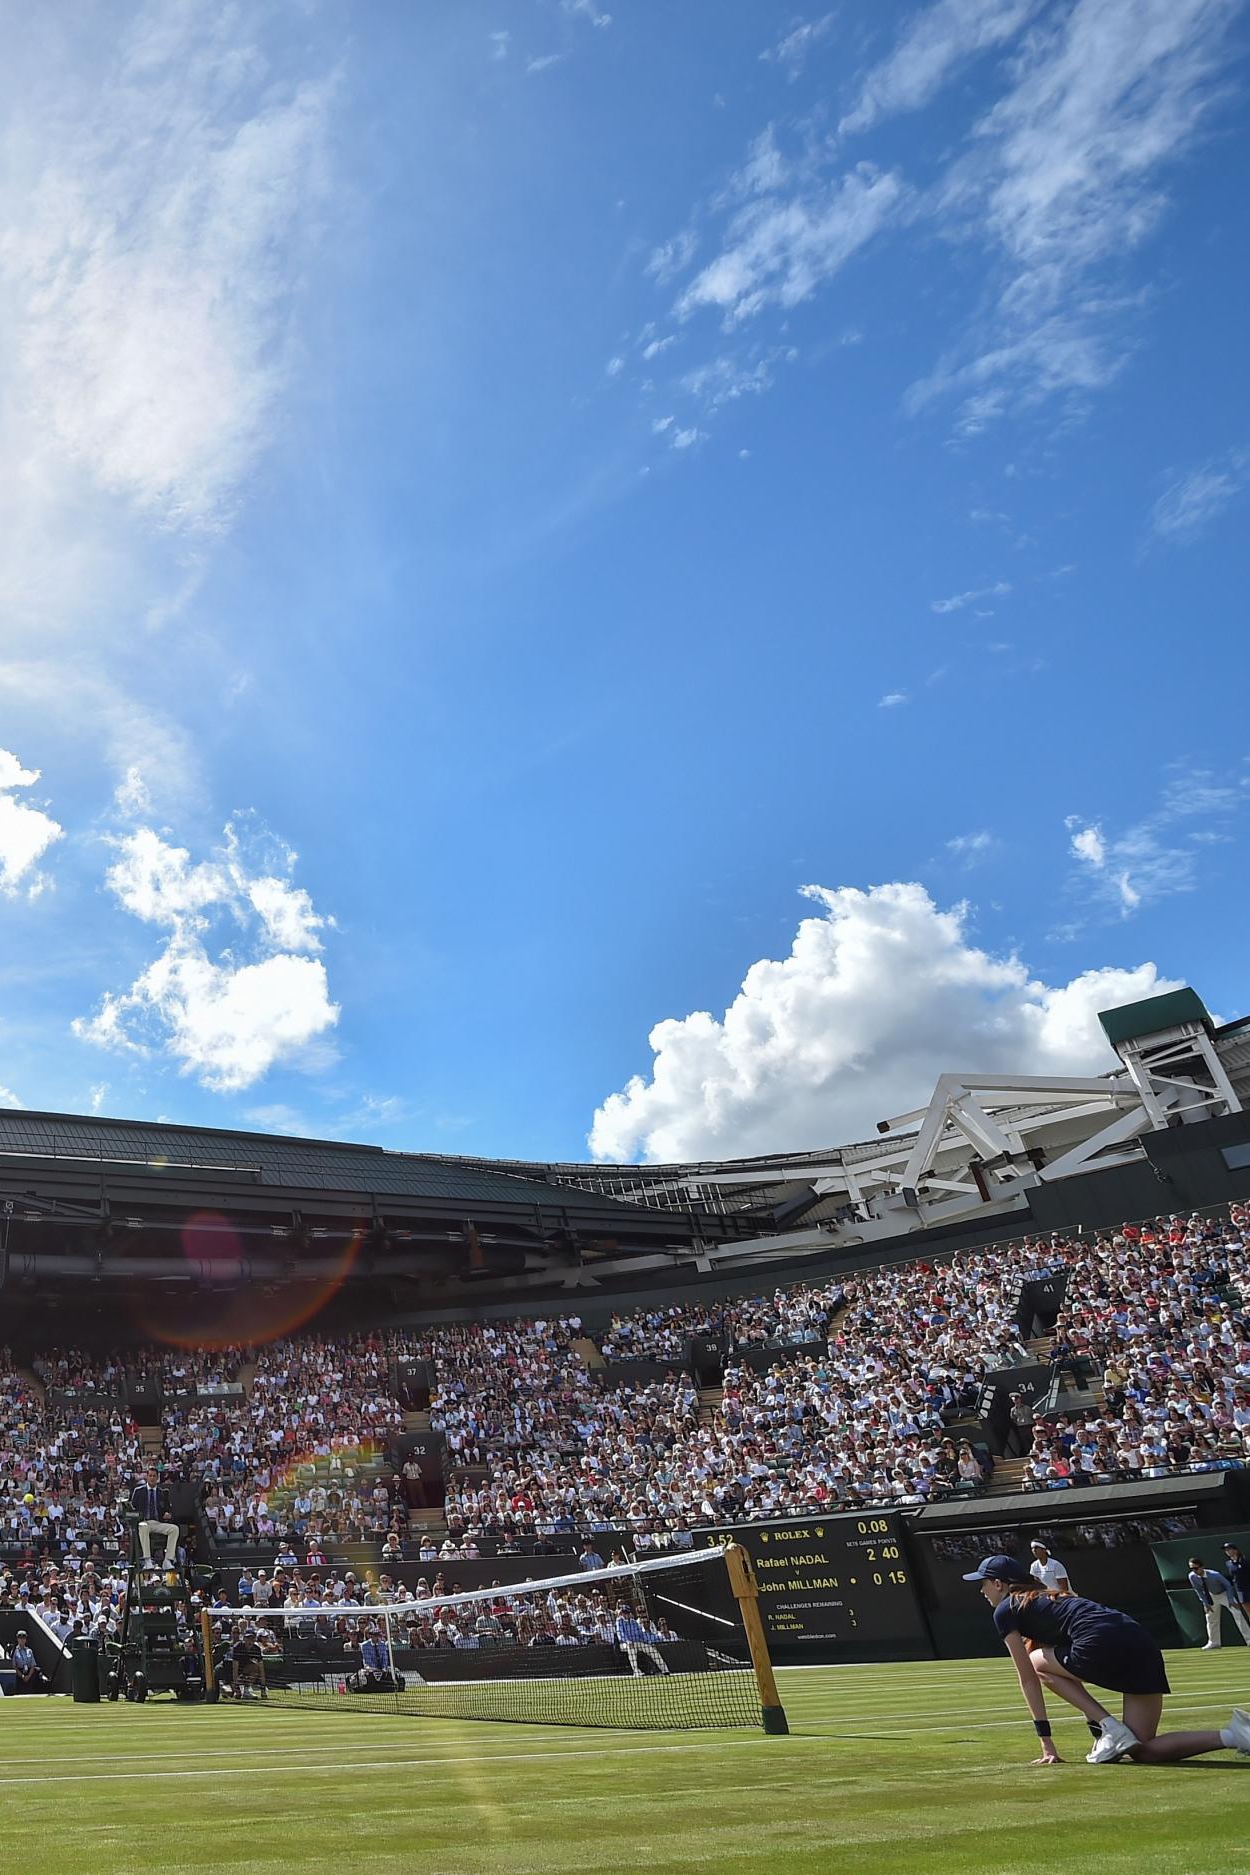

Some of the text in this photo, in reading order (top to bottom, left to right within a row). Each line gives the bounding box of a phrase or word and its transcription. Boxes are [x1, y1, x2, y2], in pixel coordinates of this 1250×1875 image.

[1043, 1284, 1055, 1293] 41
[706, 1343, 717, 1351] 39
[406, 1368, 417, 1376] 37
[135, 1385, 145, 1393] 35
[1018, 1381, 1035, 1393] 34
[413, 1446, 426, 1455] 32
[857, 1519, 888, 1534] 0.08
[774, 1529, 811, 1541] ROLEX
[706, 1534, 734, 1548] 3.52
[877, 1537, 897, 1545] POINTS
[756, 1546, 899, 1568] Rafael NADAL 2 40
[760, 1571, 906, 1592] John MILLMAN 0 15
[776, 1602, 812, 1610] CHALLENGES
